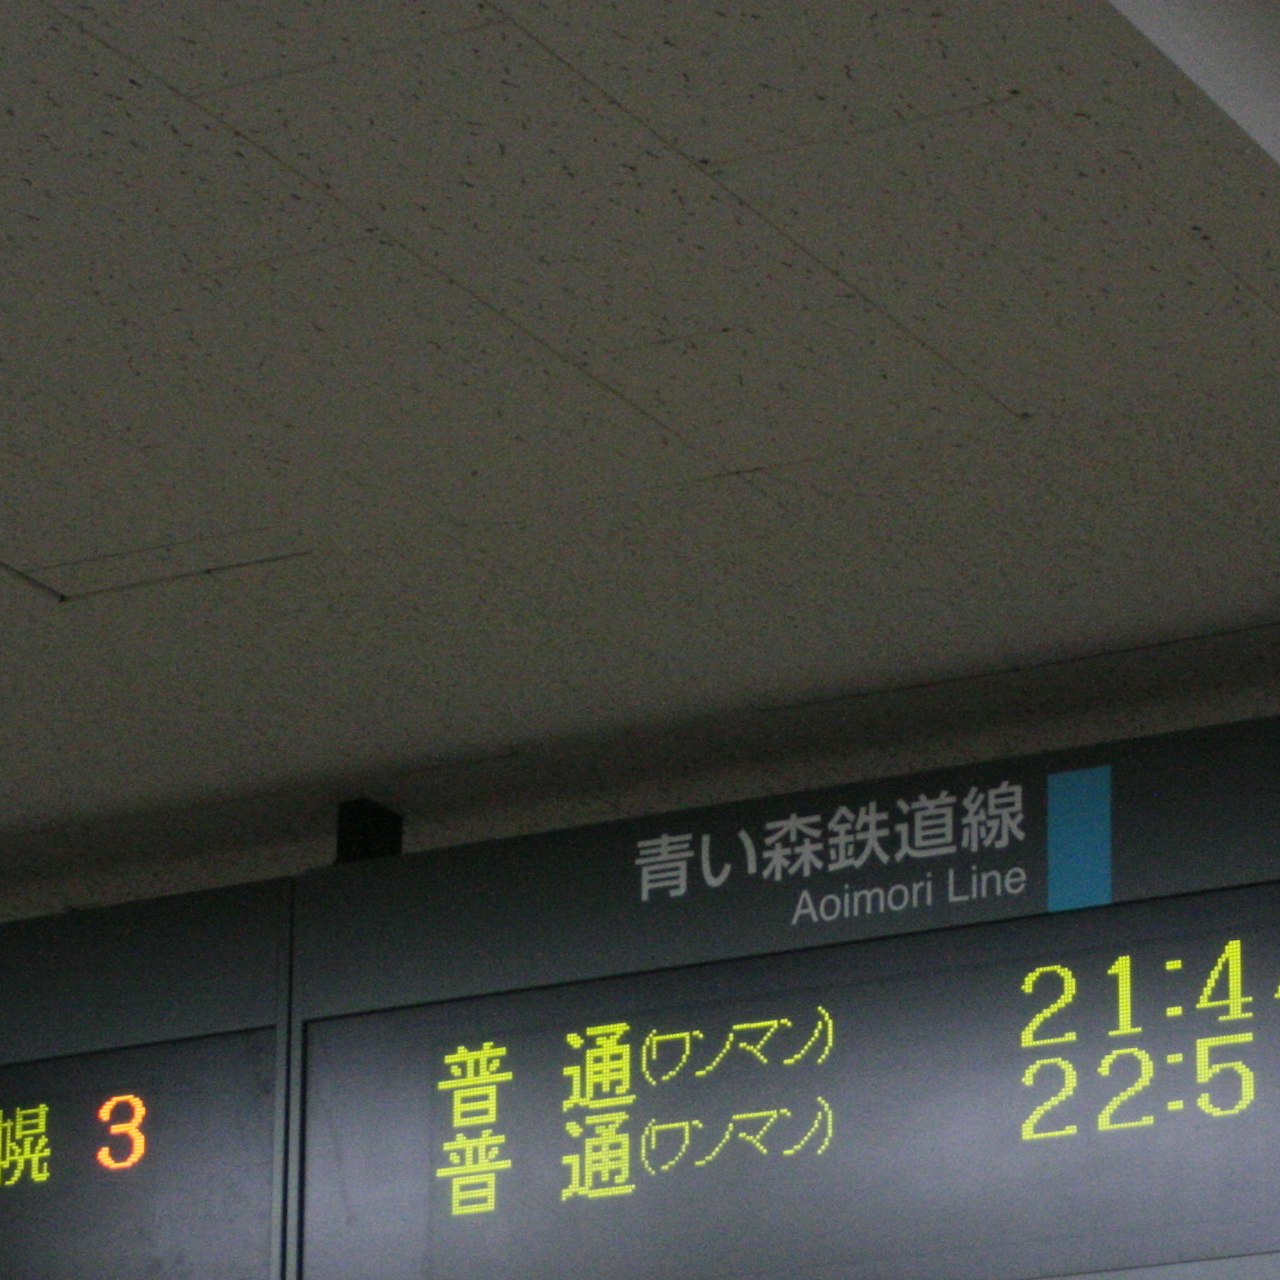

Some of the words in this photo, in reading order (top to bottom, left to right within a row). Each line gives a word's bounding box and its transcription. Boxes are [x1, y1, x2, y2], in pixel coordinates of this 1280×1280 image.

[634, 781, 1026, 901] 青い森鉄道線
[791, 876, 933, 926] Aoimori
[947, 862, 1027, 903] Line
[97, 1094, 147, 1170] 3
